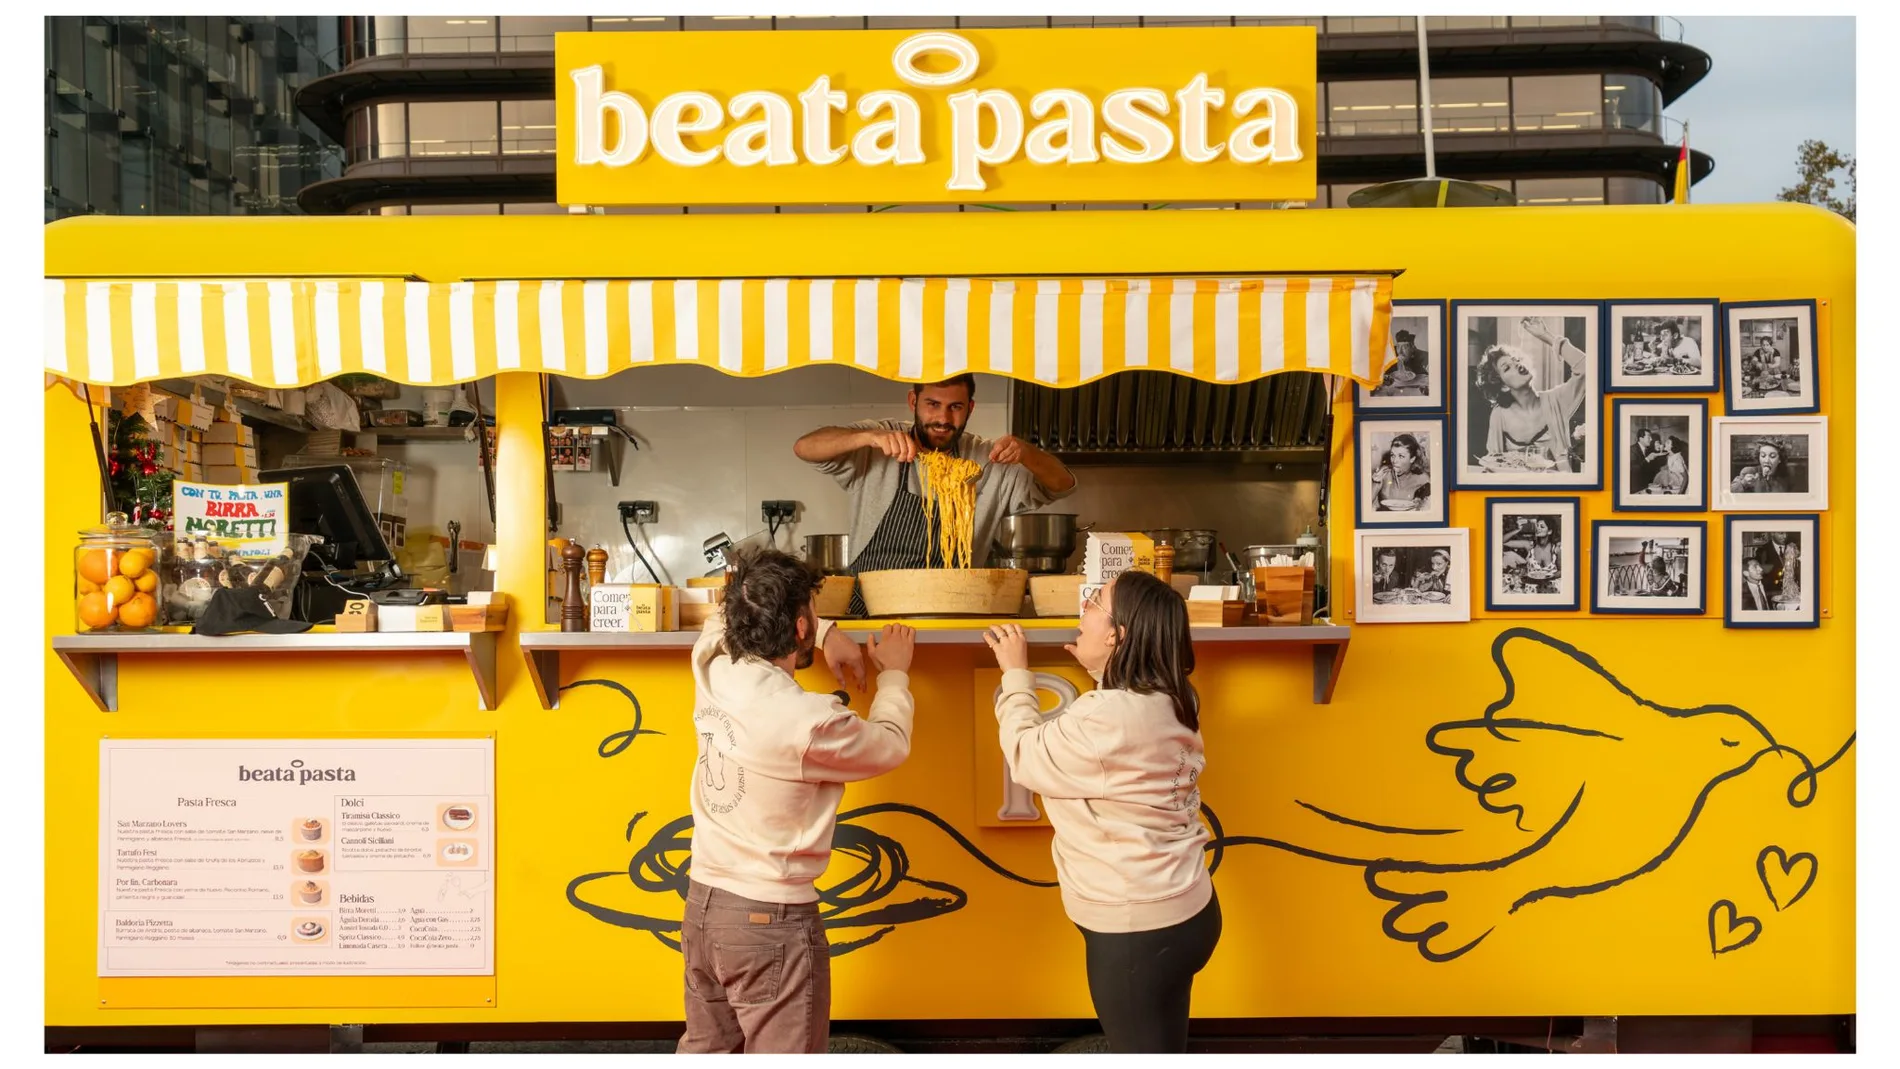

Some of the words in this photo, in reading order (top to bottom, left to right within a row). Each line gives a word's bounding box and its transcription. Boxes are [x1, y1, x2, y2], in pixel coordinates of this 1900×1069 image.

[570, 63, 925, 168] beata
[946, 72, 1302, 191] pasta
[181, 486, 205, 498] CON
[205, 500, 259, 518] BIRRA
[185, 517, 276, 539] MORETTI
[1101, 557, 1122, 570] para
[593, 605, 617, 617] para
[592, 618, 624, 628] creer.
[238, 765, 295, 782] beata
[299, 767, 356, 786] pasta
[177, 797, 204, 807] Pasta
[205, 797, 237, 807] Fresca
[341, 798, 364, 807] Dolci
[340, 893, 375, 903] Bebidas
